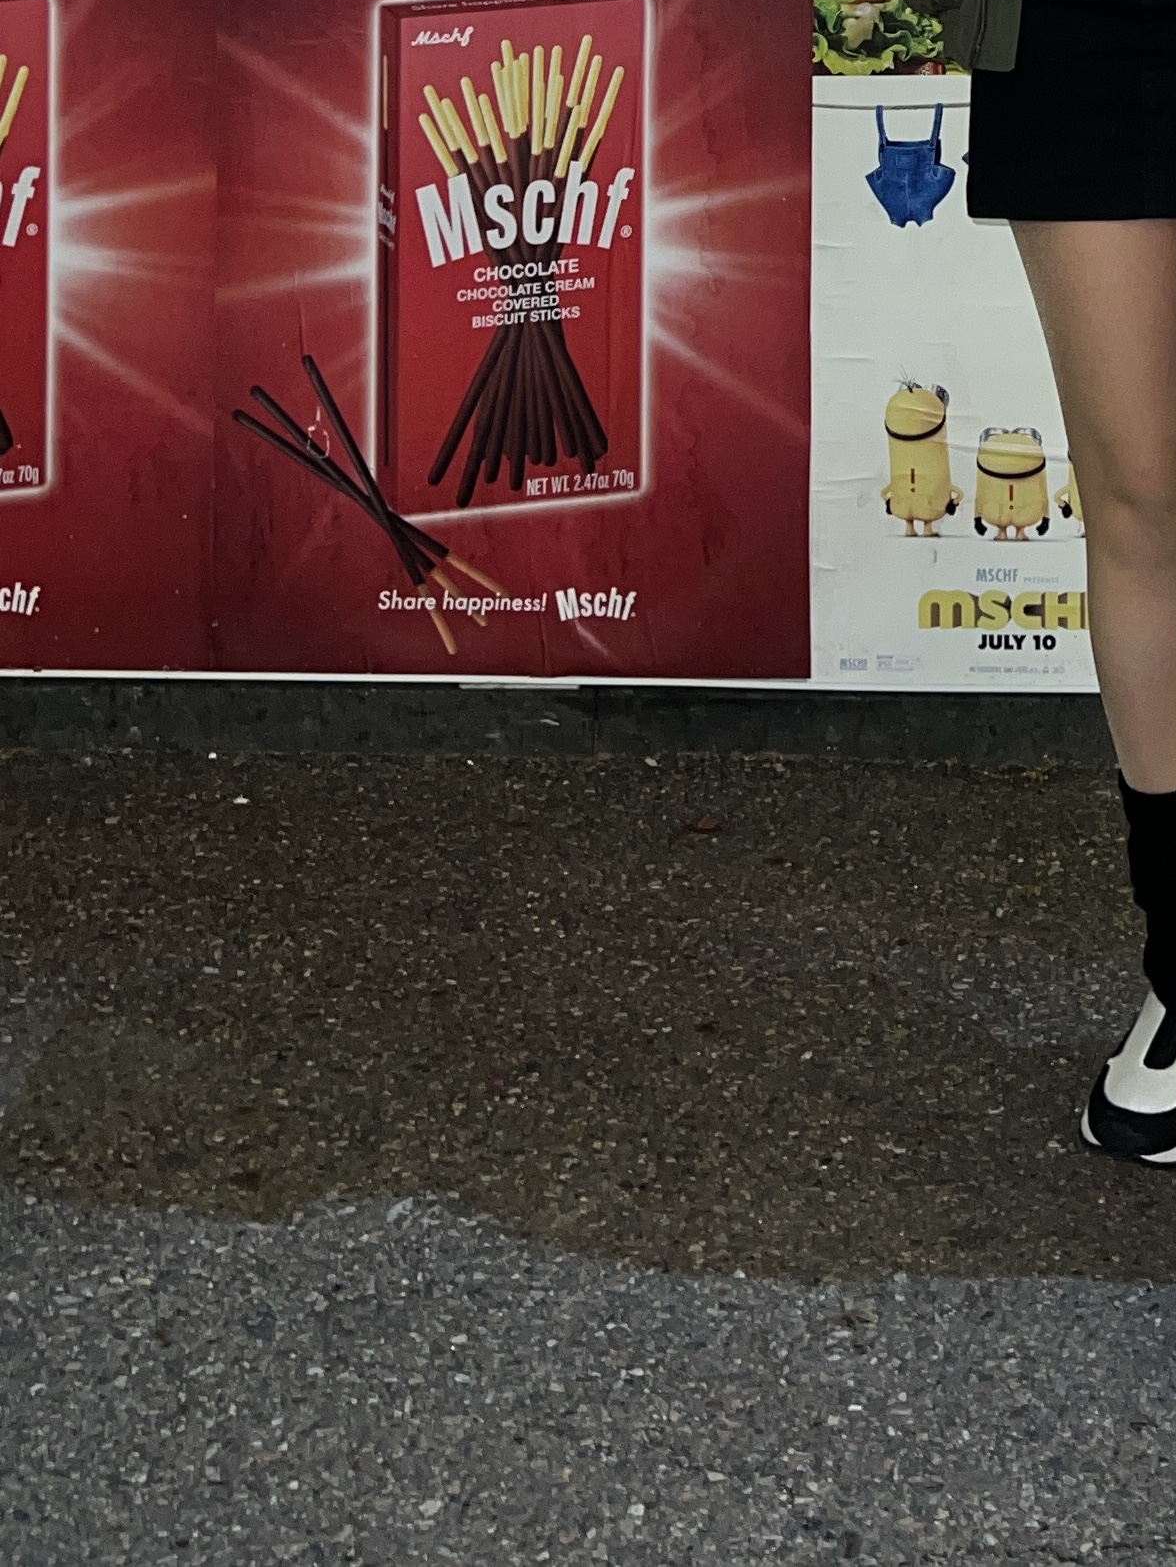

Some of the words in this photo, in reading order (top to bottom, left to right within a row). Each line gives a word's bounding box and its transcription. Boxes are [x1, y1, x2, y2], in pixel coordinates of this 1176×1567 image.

[411, 26, 474, 47] Mschf
[473, 258, 579, 282] CHOCOLATE
[457, 282, 542, 302] CHOCOLATE
[545, 277, 595, 294] CREAM
[492, 295, 559, 312] COVERED
[472, 311, 527, 328] BISCUIT
[530, 306, 580, 322] STICKS
[18, 465, 39, 483] 70g
[527, 478, 548, 496] NET
[573, 473, 609, 491] 2.47oz
[613, 469, 634, 489] 70g
[976, 568, 1019, 583] MSCHF
[378, 590, 436, 610] Share
[443, 590, 547, 616] happiness!
[918, 589, 1090, 630] MSCH
[978, 634, 1027, 650] JULY
[1032, 634, 1057, 650] 10
